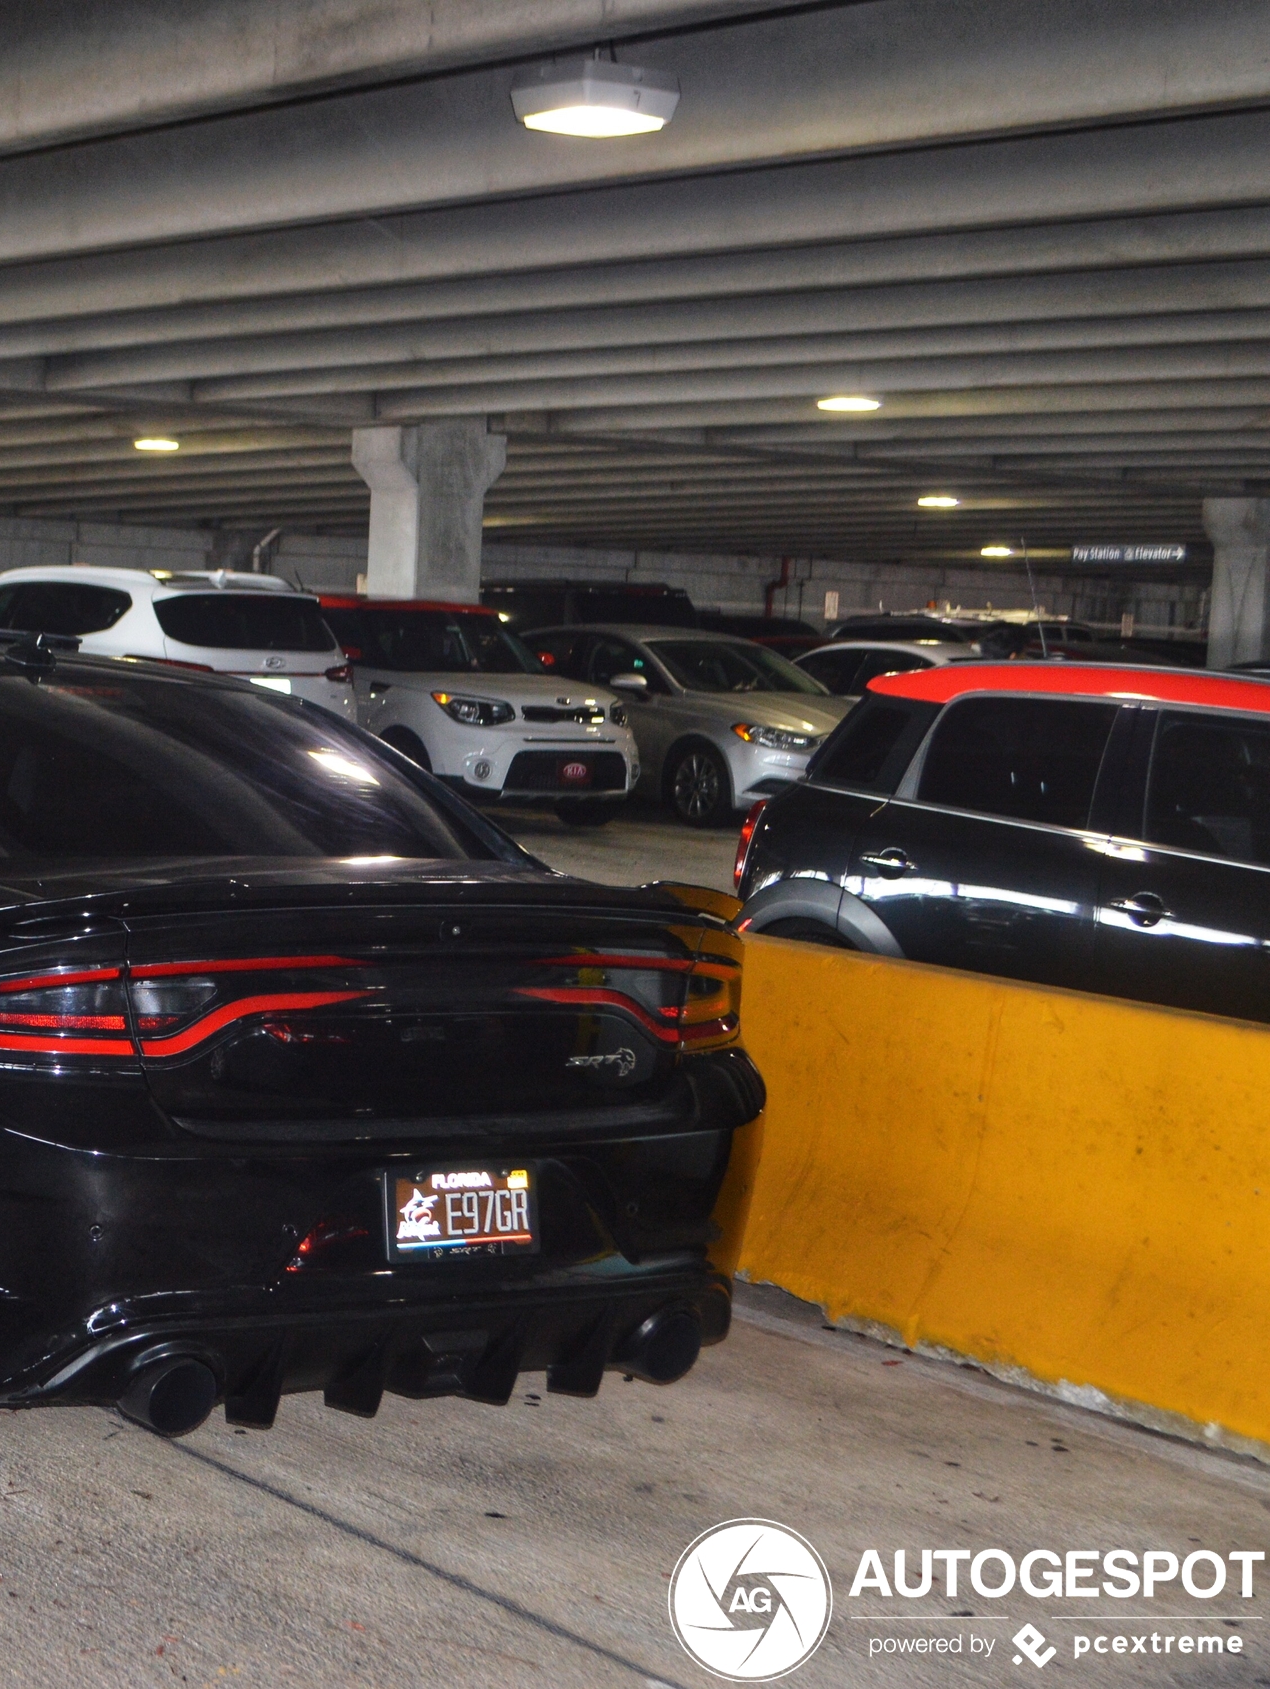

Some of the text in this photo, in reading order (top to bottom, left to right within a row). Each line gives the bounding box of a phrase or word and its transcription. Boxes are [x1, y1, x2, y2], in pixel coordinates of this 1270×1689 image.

[1073, 547, 1089, 562] Pay
[1090, 546, 1120, 560] Station
[431, 1171, 492, 1189] FLORIDA
[445, 1189, 529, 1236] E97GR
